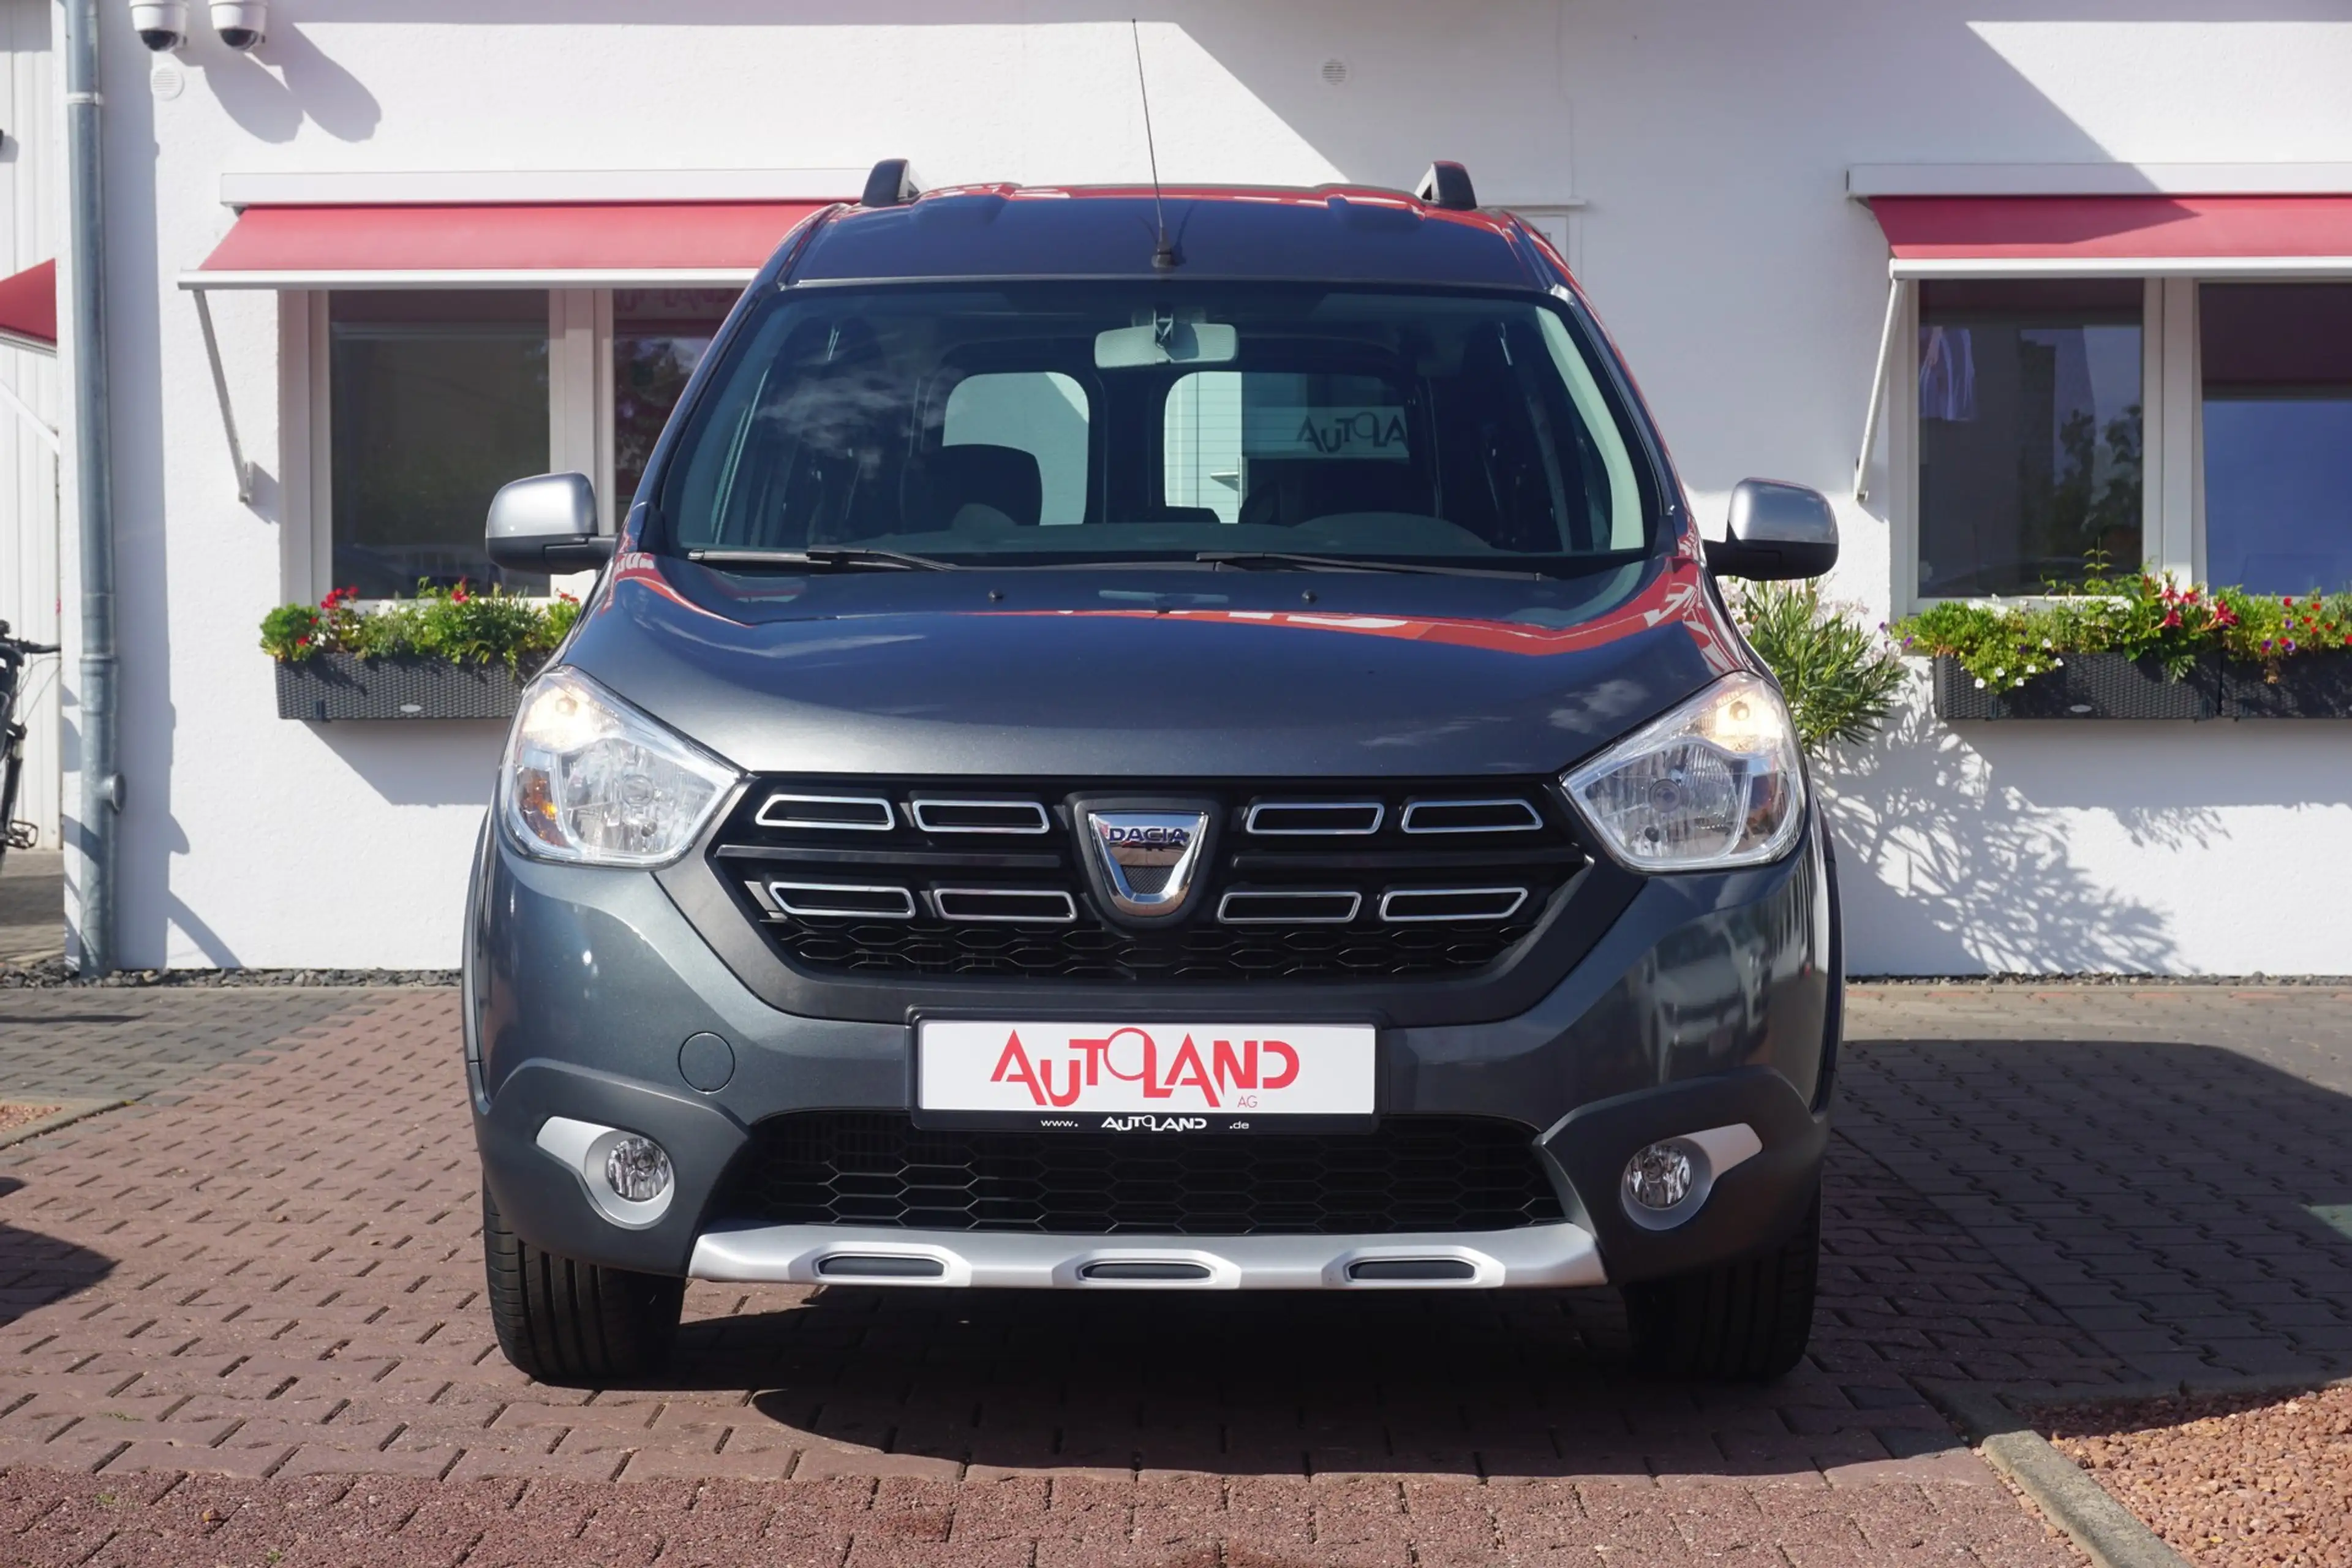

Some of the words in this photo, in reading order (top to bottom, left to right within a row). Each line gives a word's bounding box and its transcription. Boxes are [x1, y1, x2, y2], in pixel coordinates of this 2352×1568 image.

[1109, 827, 1188, 842] DACIA
[991, 1027, 1300, 1108] AUTOLAND
[1237, 1095, 1258, 1108] AG
[1040, 1119, 1079, 1128] www.
[1101, 1114, 1207, 1132] AUTOLAND
[1229, 1120, 1250, 1129] .de
